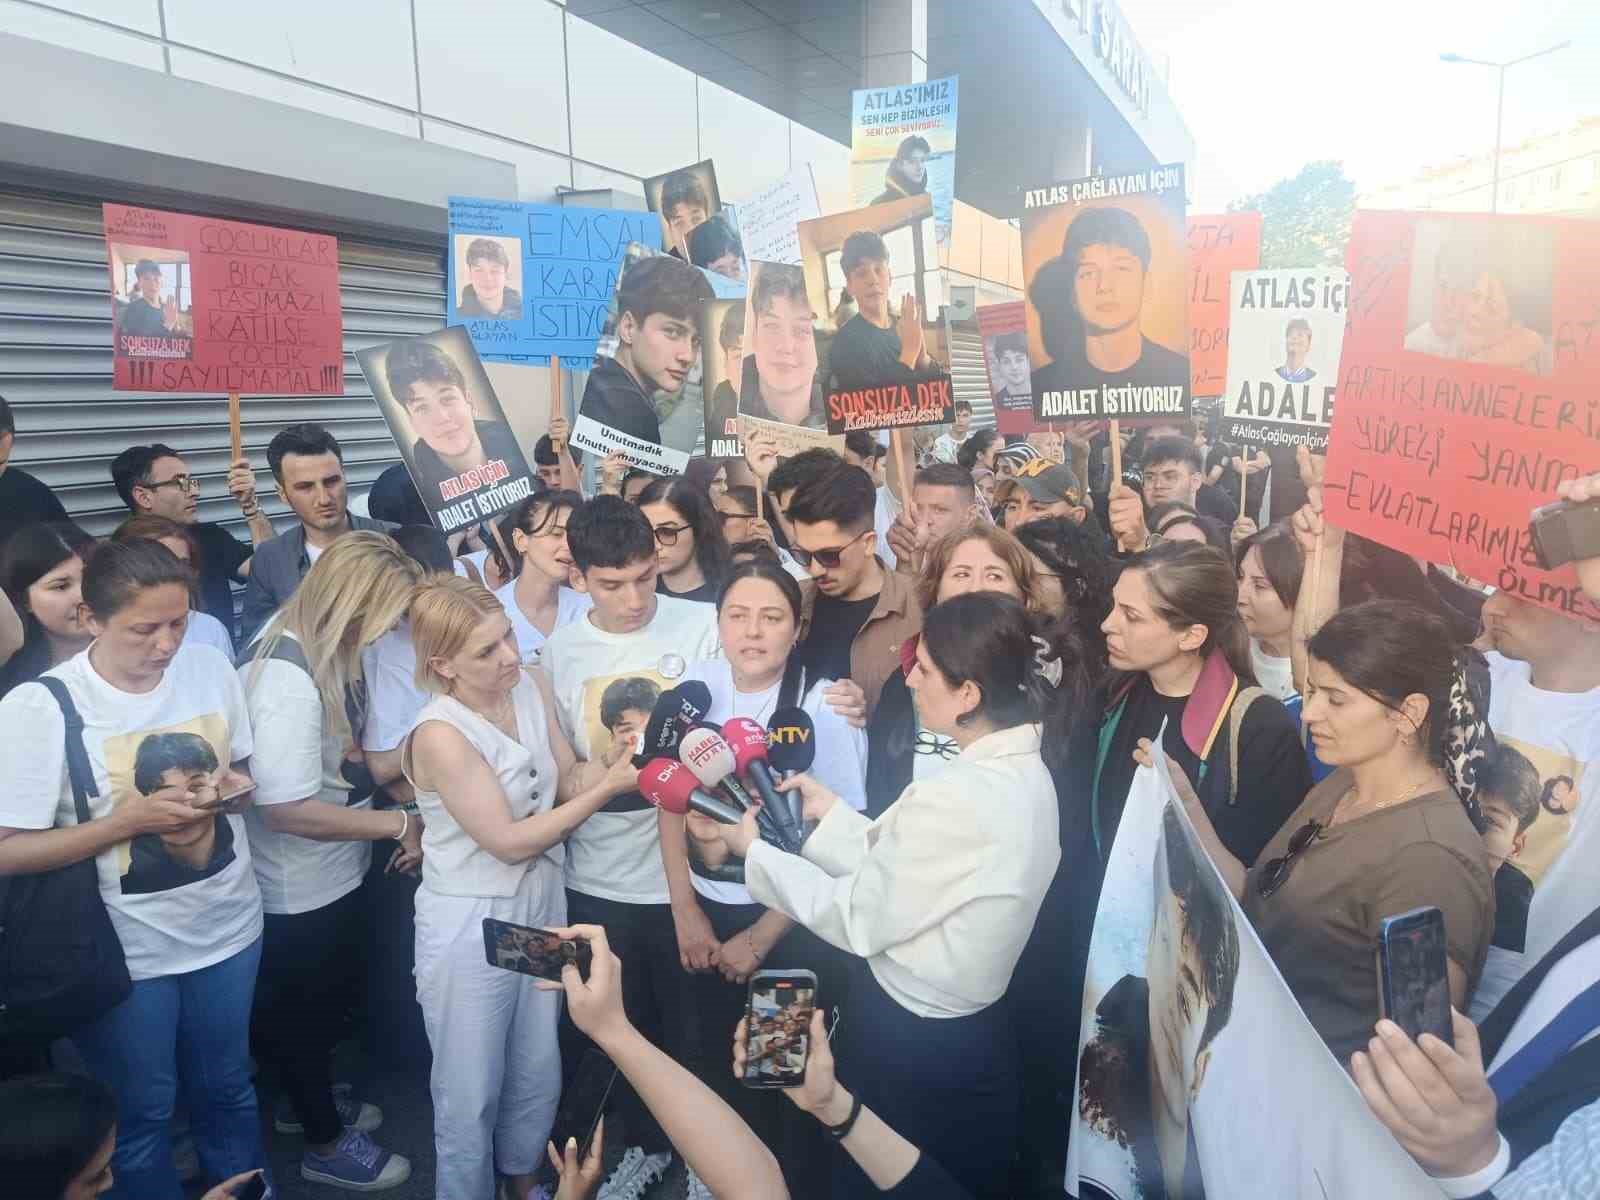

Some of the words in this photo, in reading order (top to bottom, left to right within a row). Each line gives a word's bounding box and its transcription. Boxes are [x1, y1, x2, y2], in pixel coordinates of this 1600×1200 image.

[861, 113, 879, 126] SEN
[881, 111, 899, 123] HEP
[1024, 185, 1068, 209] ATLAS
[1072, 172, 1147, 206] ÇAĞLAYAN
[228, 260, 301, 290] BIÇAK
[1240, 276, 1316, 309] ATLAS
[828, 383, 913, 420] SONSUZA
[916, 377, 952, 412] DEK
[1041, 388, 1098, 416] ADALET
[1102, 381, 1185, 414] İSTİYORUZ
[1235, 380, 1336, 423] ADALE
[1432, 376, 1600, 441] ANNELERİ
[600, 427, 663, 457] Unutmadık
[1465, 439, 1600, 493] YANM
[439, 469, 481, 502] ATLAS
[437, 498, 479, 532] ADALET
[474, 476, 536, 515] İSTİYORUZ
[767, 726, 810, 744] NTV
